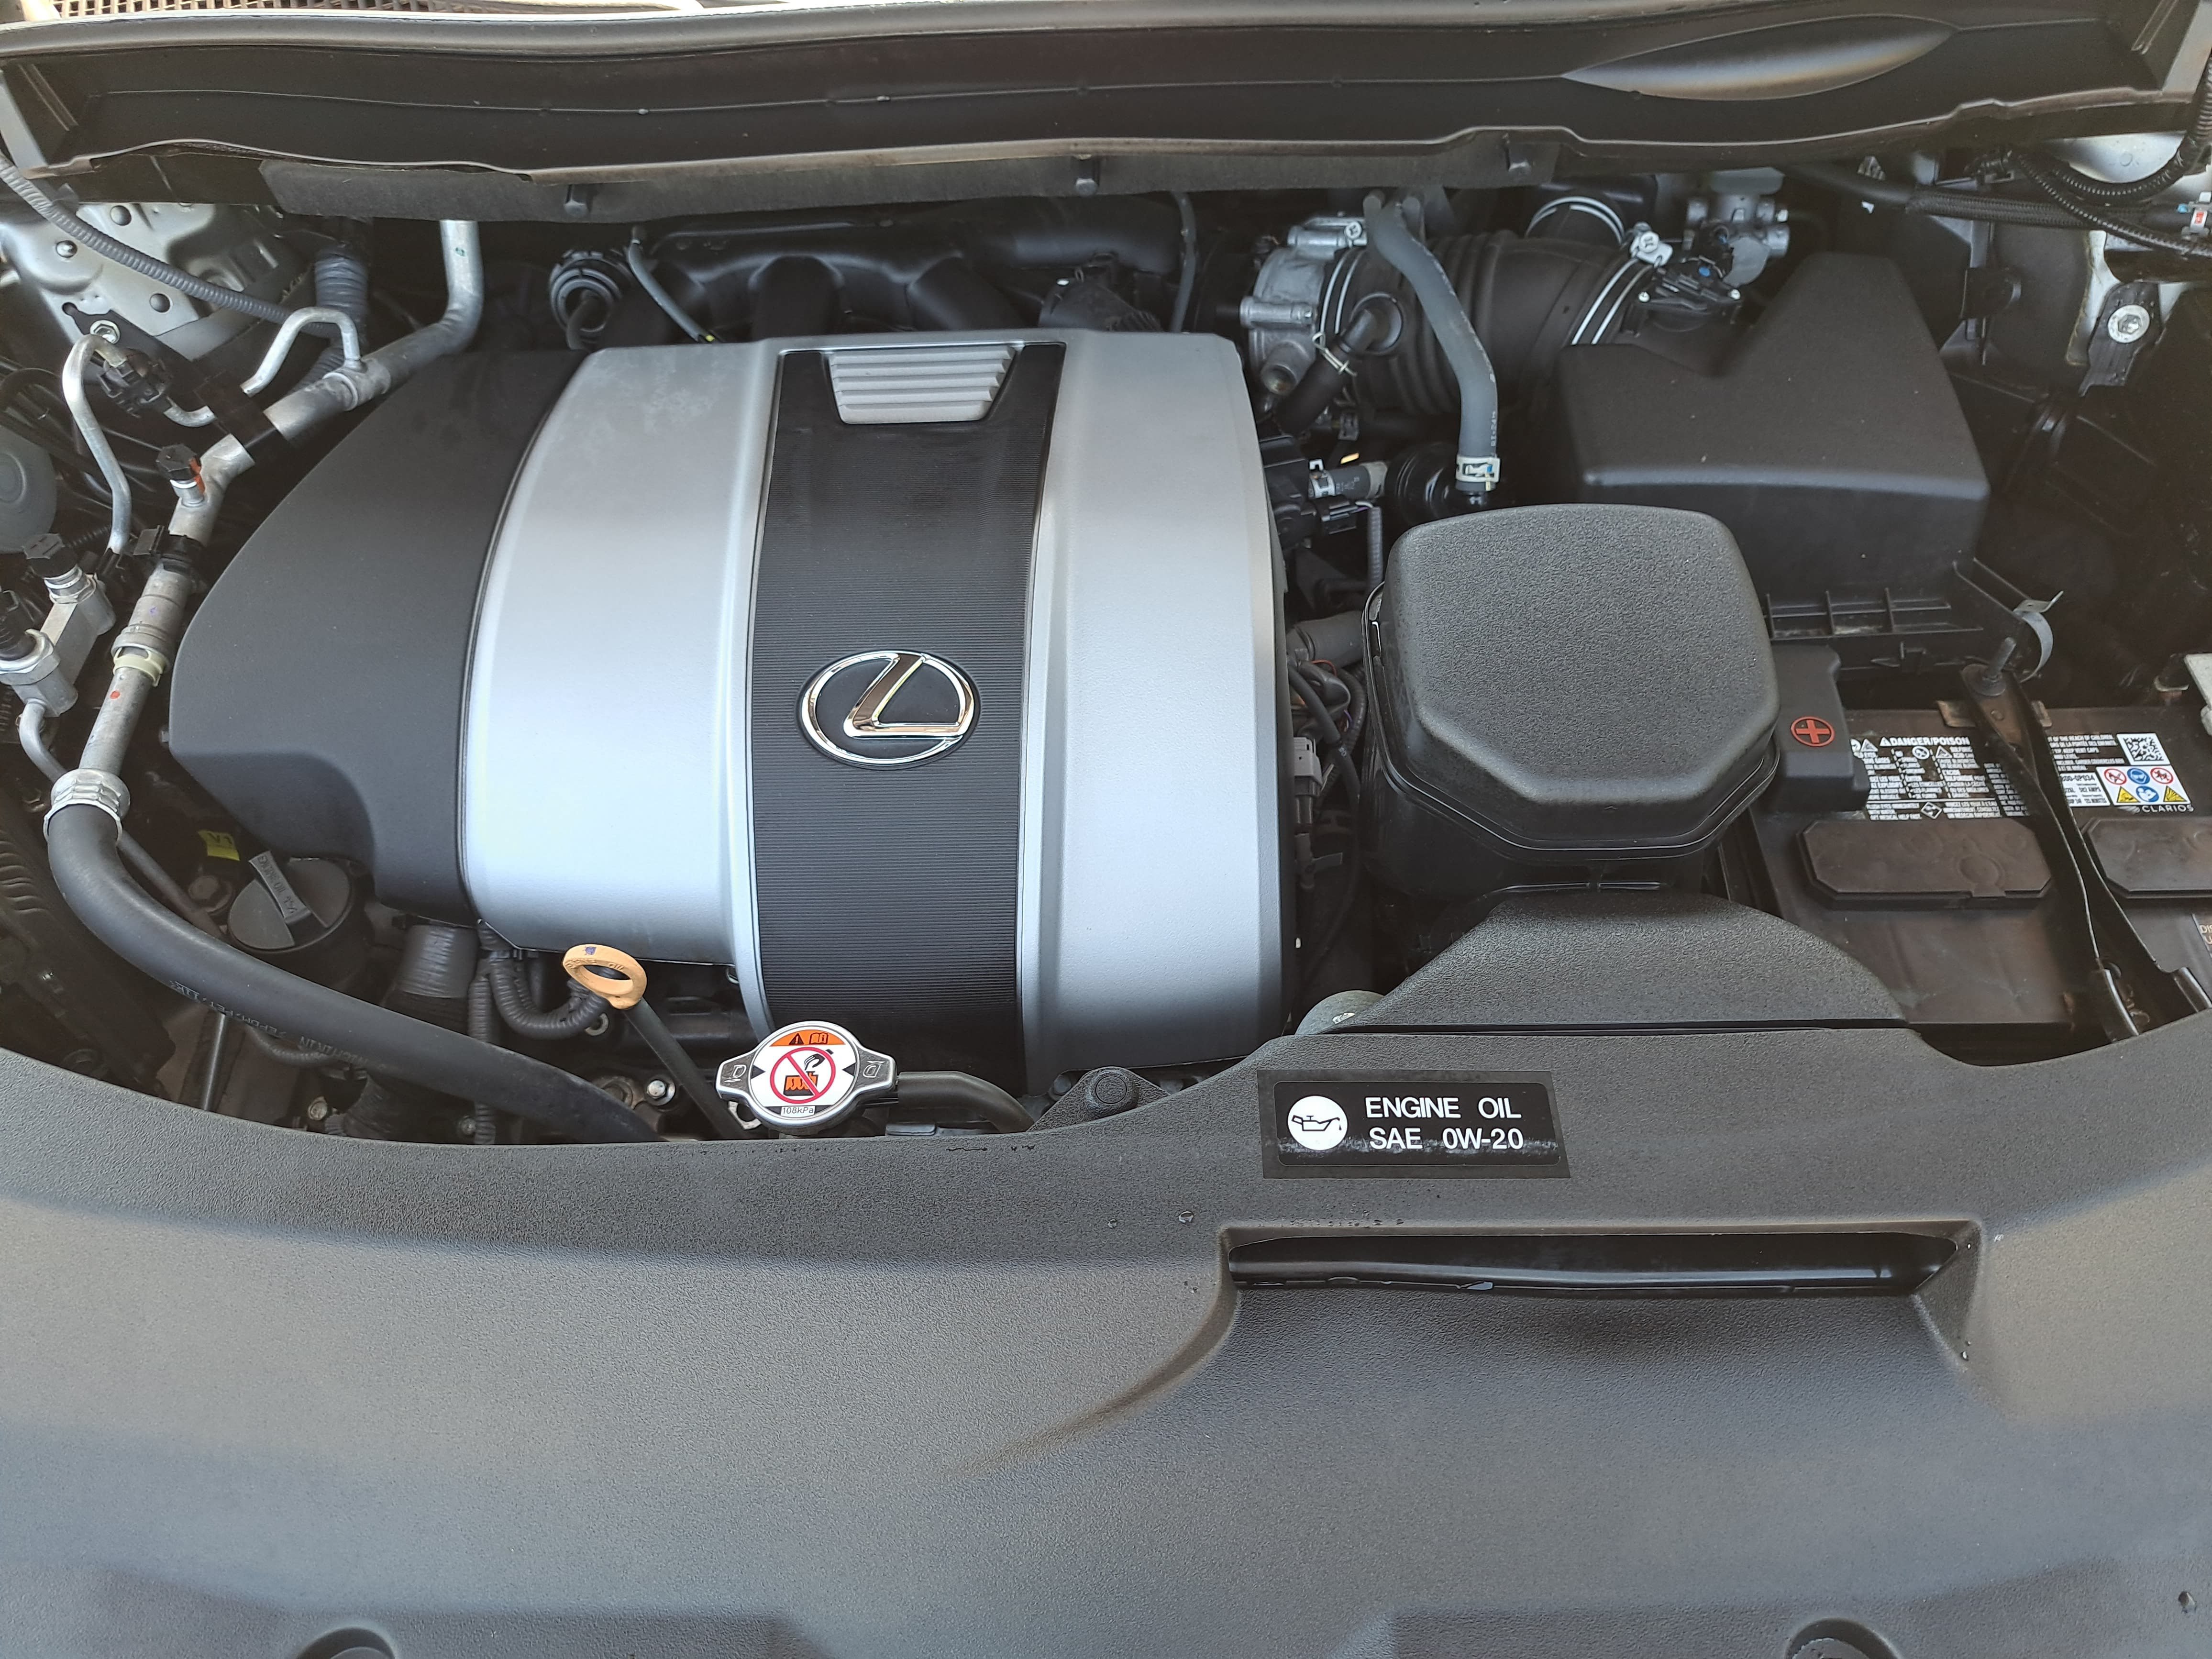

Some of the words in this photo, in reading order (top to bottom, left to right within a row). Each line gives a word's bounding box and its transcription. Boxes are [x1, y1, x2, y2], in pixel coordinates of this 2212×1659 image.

[1890, 737, 1970, 746] DANGER/POISON
[2142, 804, 2194, 813] CLARIOS
[782, 1106, 814, 1115] 108kPa
[1365, 1097, 1461, 1118] ENGINE
[1478, 1097, 1522, 1119] OIL
[1369, 1127, 1423, 1150] SAE
[1442, 1128, 1524, 1150] 0W-20
